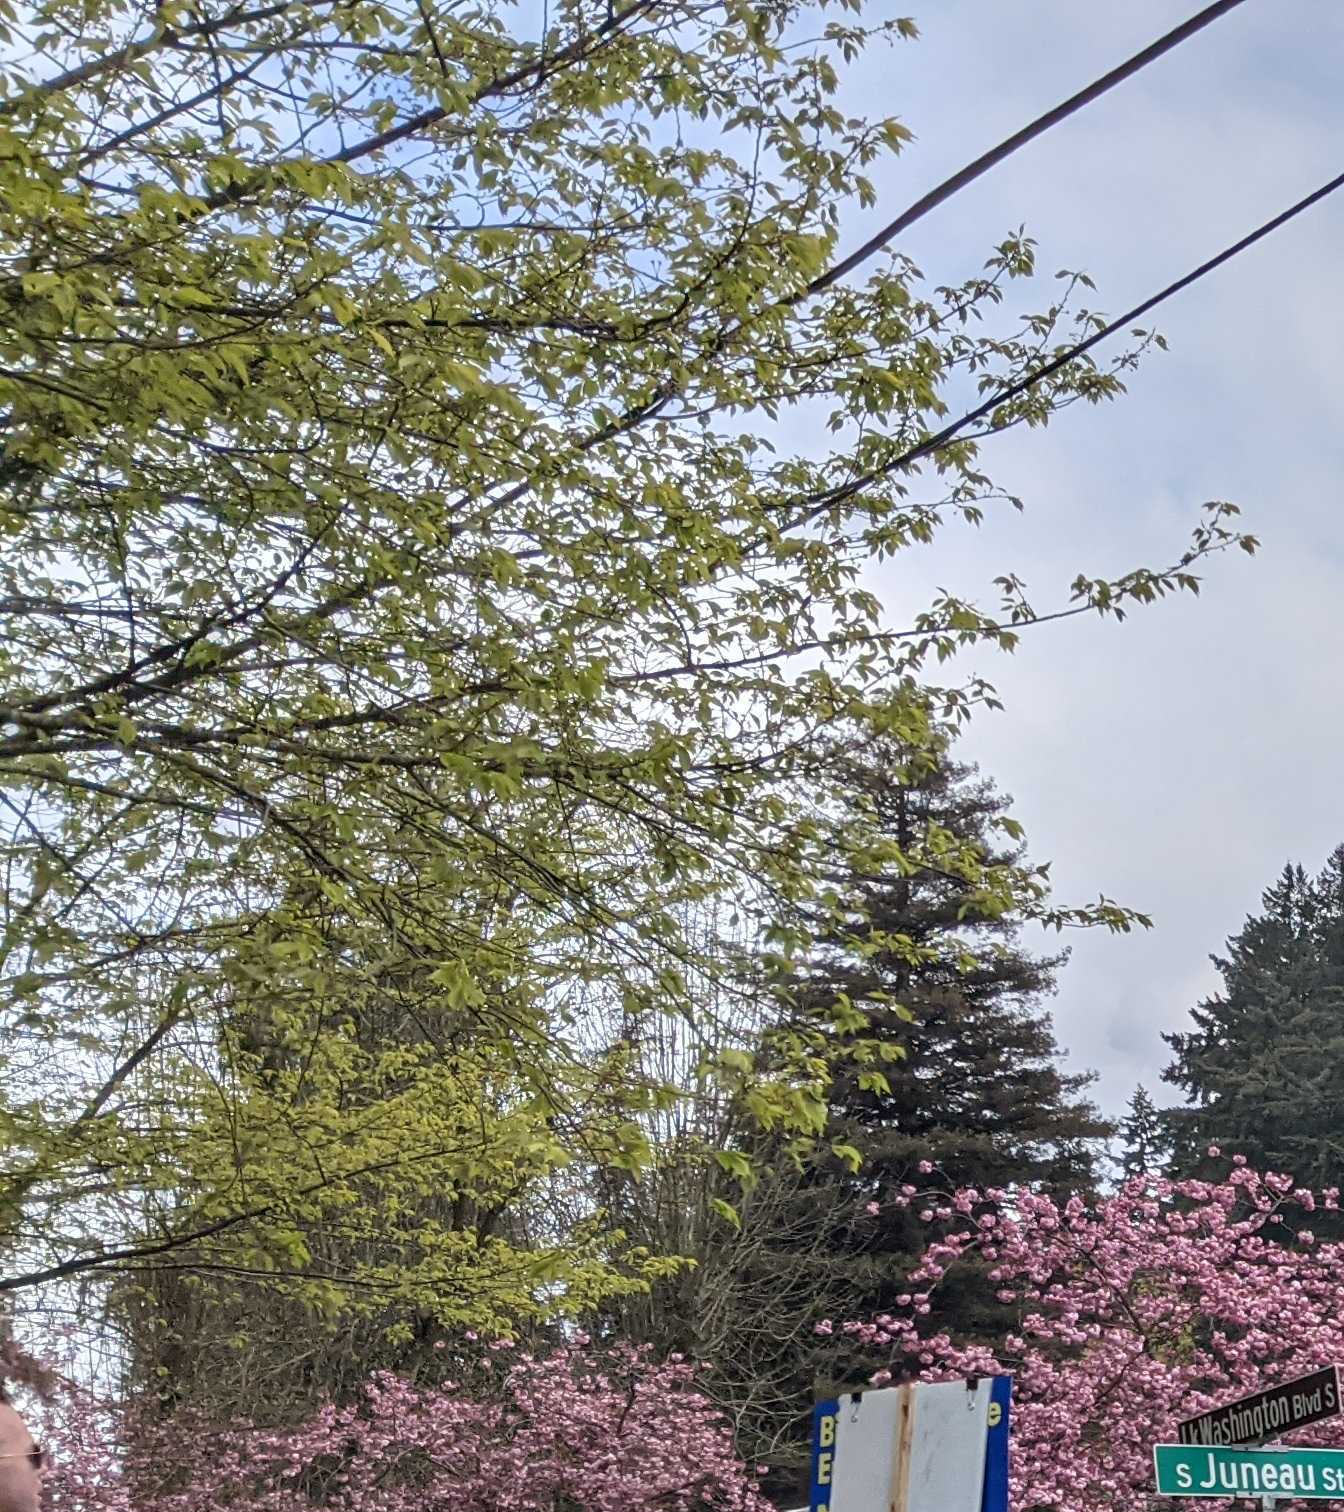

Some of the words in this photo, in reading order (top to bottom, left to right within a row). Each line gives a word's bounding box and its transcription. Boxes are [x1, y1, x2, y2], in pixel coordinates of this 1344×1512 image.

[1200, 1396, 1290, 1445] Washington
[1293, 1388, 1321, 1420] Blvd
[1324, 1382, 1335, 1408] S
[1176, 1462, 1193, 1488] S
[1199, 1452, 1316, 1491] Juneau
